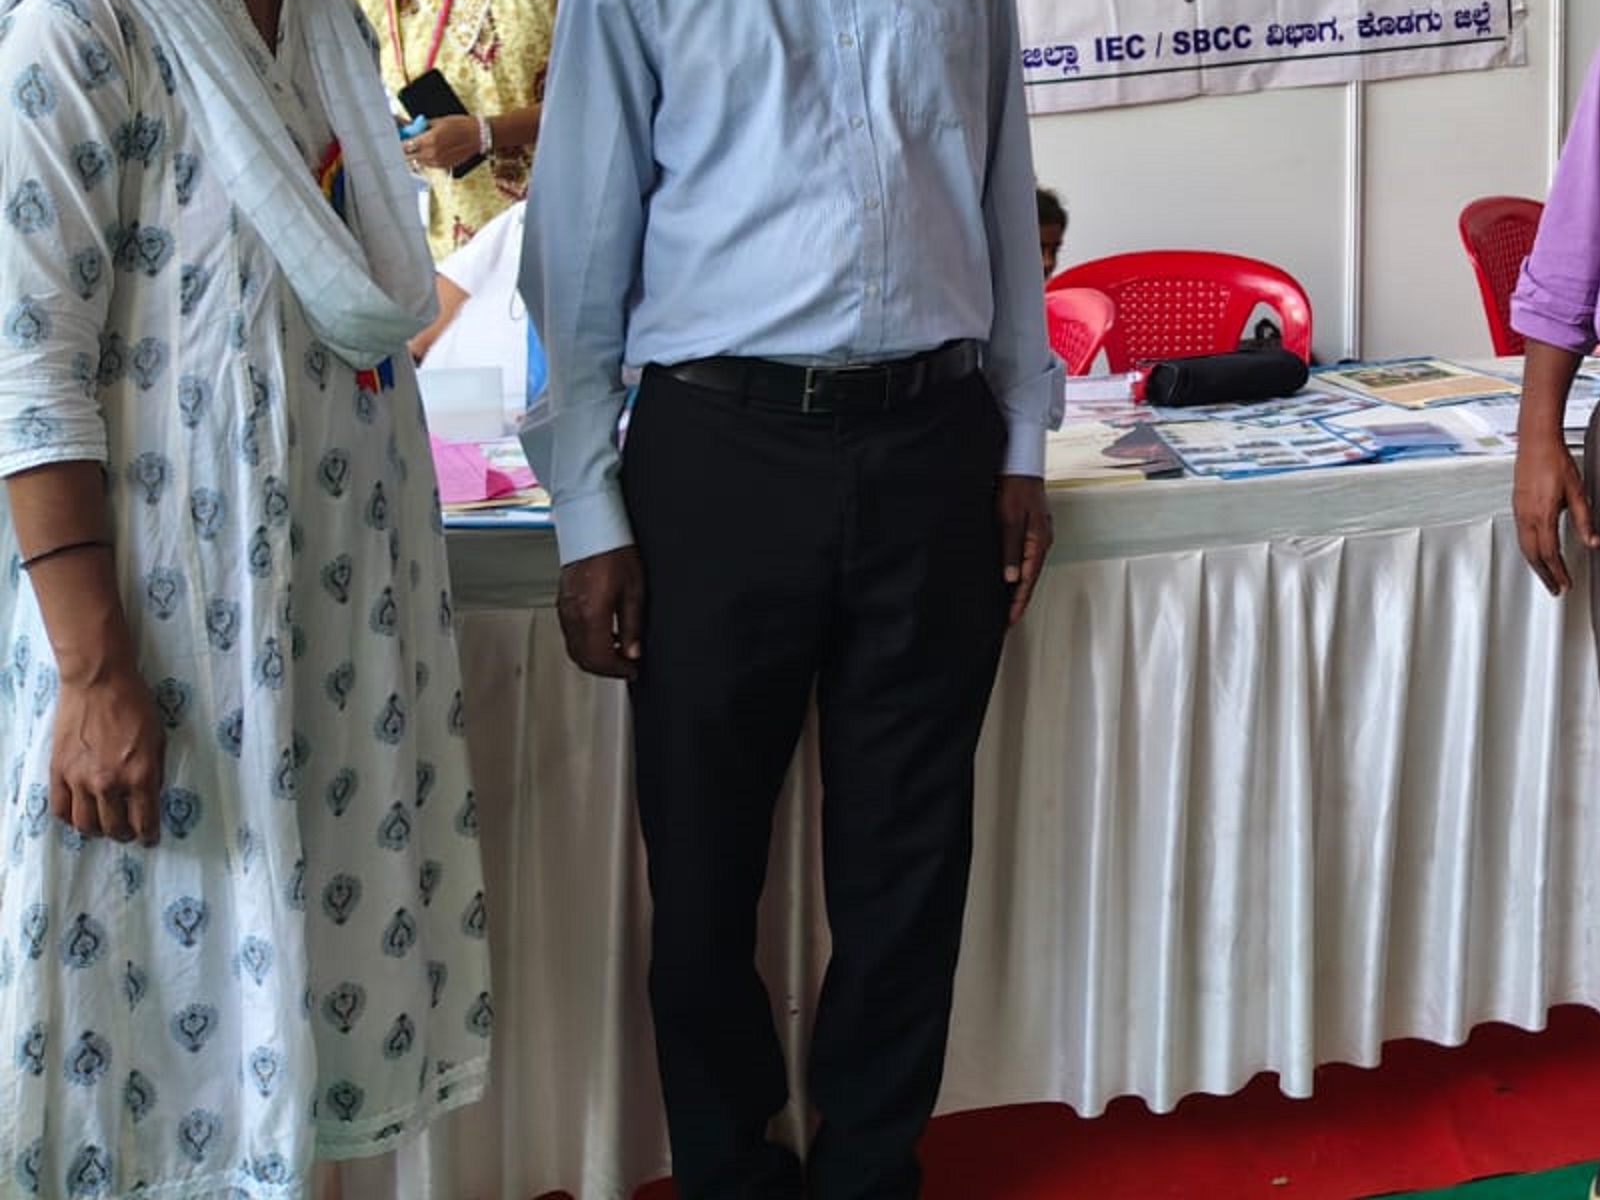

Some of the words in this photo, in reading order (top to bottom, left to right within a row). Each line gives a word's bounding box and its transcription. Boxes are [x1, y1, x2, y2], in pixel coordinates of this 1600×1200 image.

[1023, 46, 1079, 74] ಜಿಲ್ಲಾ
[1095, 34, 1145, 62] IEC
[1156, 32, 1162, 58] /
[1172, 25, 1252, 55] SBCC
[1358, 8, 1442, 39] ಕೊಡಗು
[1454, 1, 1491, 35] ಜಿಲ್ಲೆ
